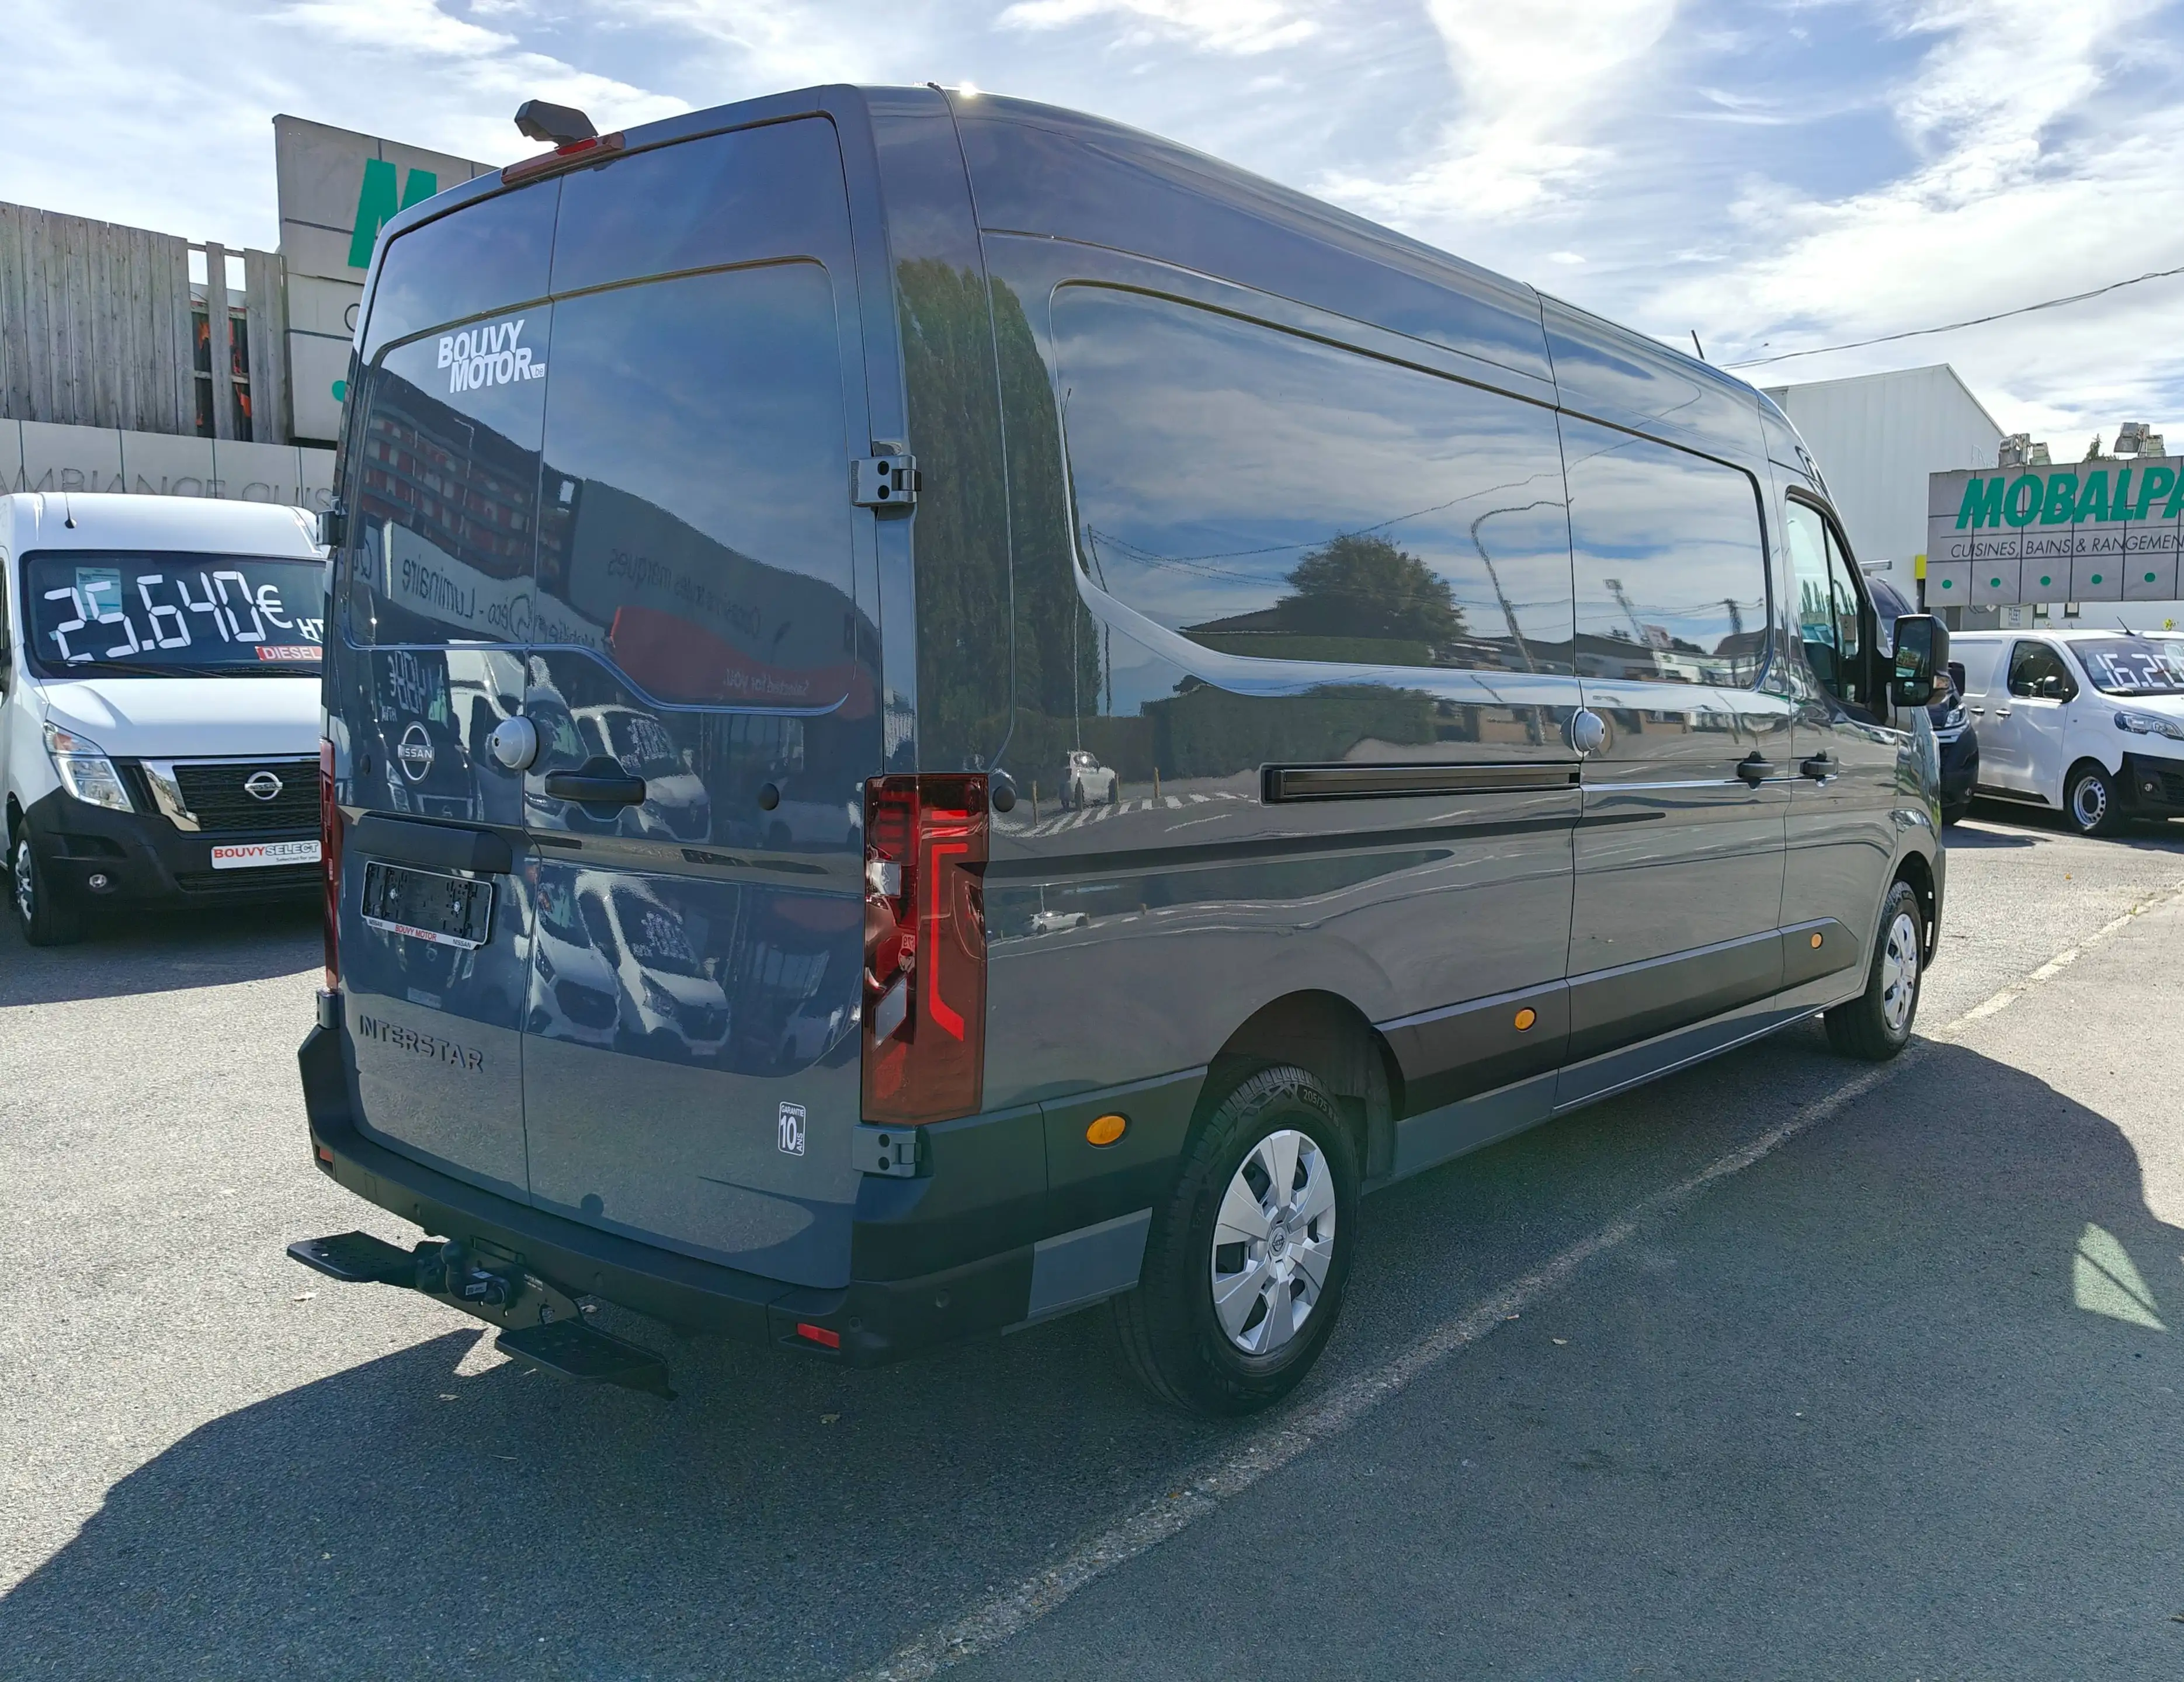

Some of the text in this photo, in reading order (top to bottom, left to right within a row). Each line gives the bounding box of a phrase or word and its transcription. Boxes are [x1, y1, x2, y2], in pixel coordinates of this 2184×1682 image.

[438, 319, 525, 369] BOUVY
[450, 347, 532, 394] MOTOR
[1951, 541, 2019, 558] CUISINES,
[2026, 539, 2071, 555] BAINS
[2076, 538, 2086, 552] &
[264, 647, 322, 660] DIESEL
[399, 748, 433, 759] NISSAN
[395, 925, 438, 941] BOUVY MOTOR
[452, 938, 473, 948] NISSAN
[359, 1014, 484, 1073] INTERSTAR
[780, 1104, 804, 1117] GARANTIE
[780, 1115, 804, 1152] 10 ANS
